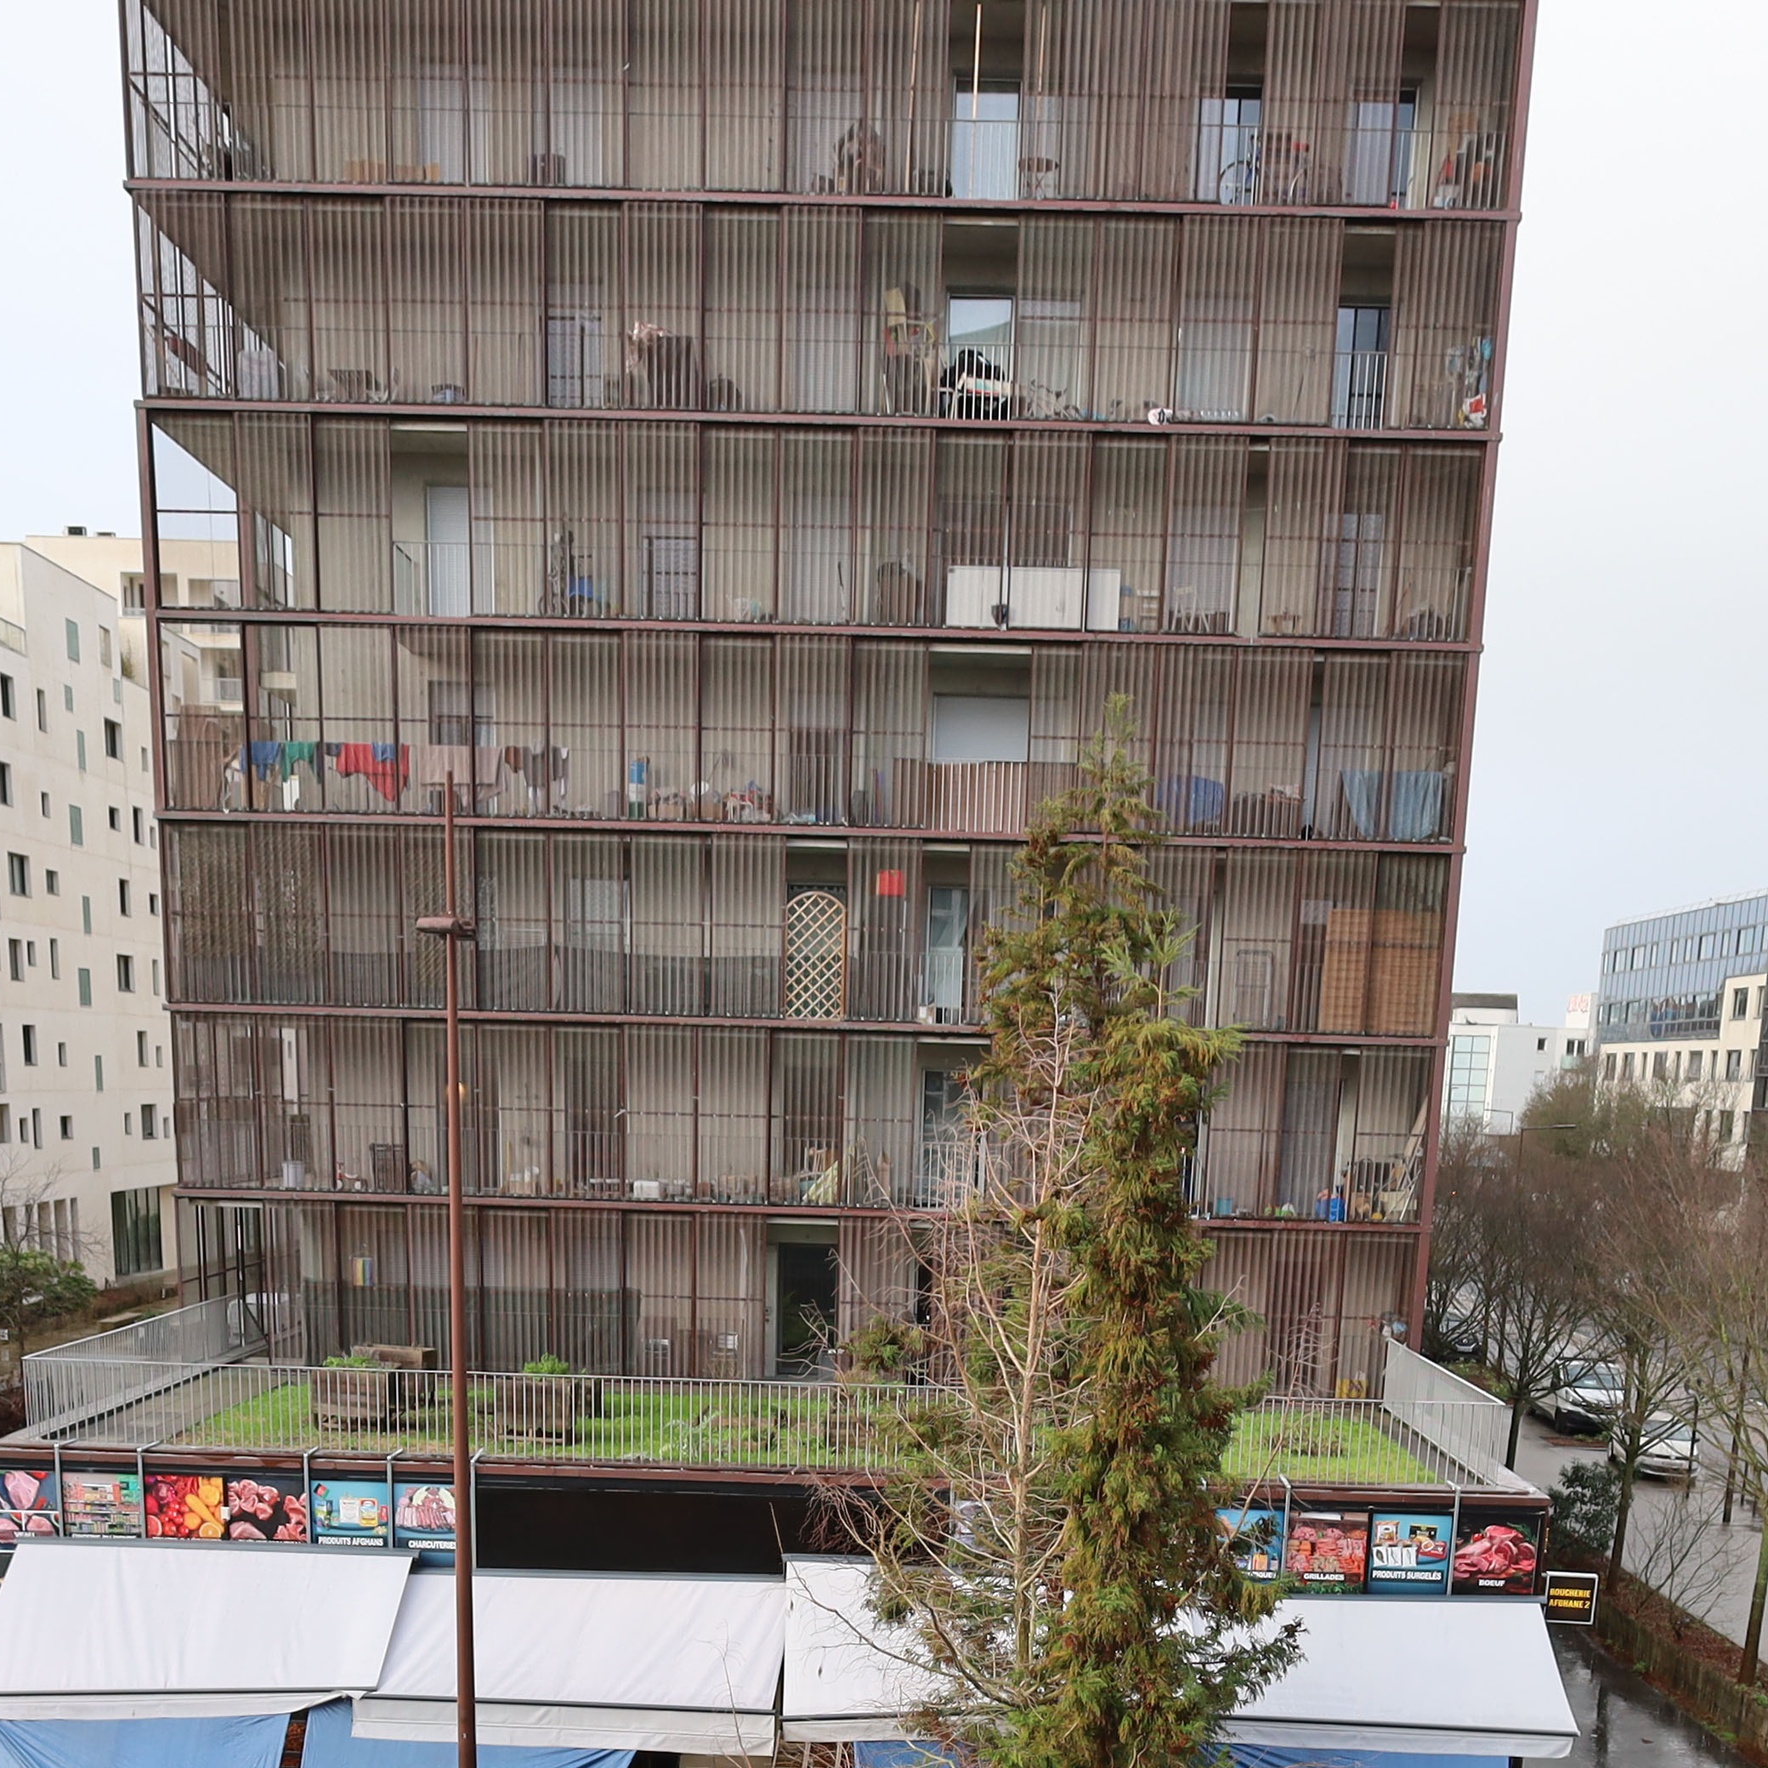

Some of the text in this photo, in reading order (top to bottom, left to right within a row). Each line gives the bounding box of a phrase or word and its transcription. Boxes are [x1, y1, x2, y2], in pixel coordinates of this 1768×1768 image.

[317, 1536, 384, 1547] PRODUITS AFGHANS
[1303, 1572, 1345, 1582] GRILLADES
[1372, 1569, 1442, 1581] PRODUITS SURGELÉS
[1479, 1579, 1505, 1587] BOEUF
[1549, 1587, 1591, 1598] BOUCHERIE
[1548, 1599, 1590, 1609] AFGHANE 2
